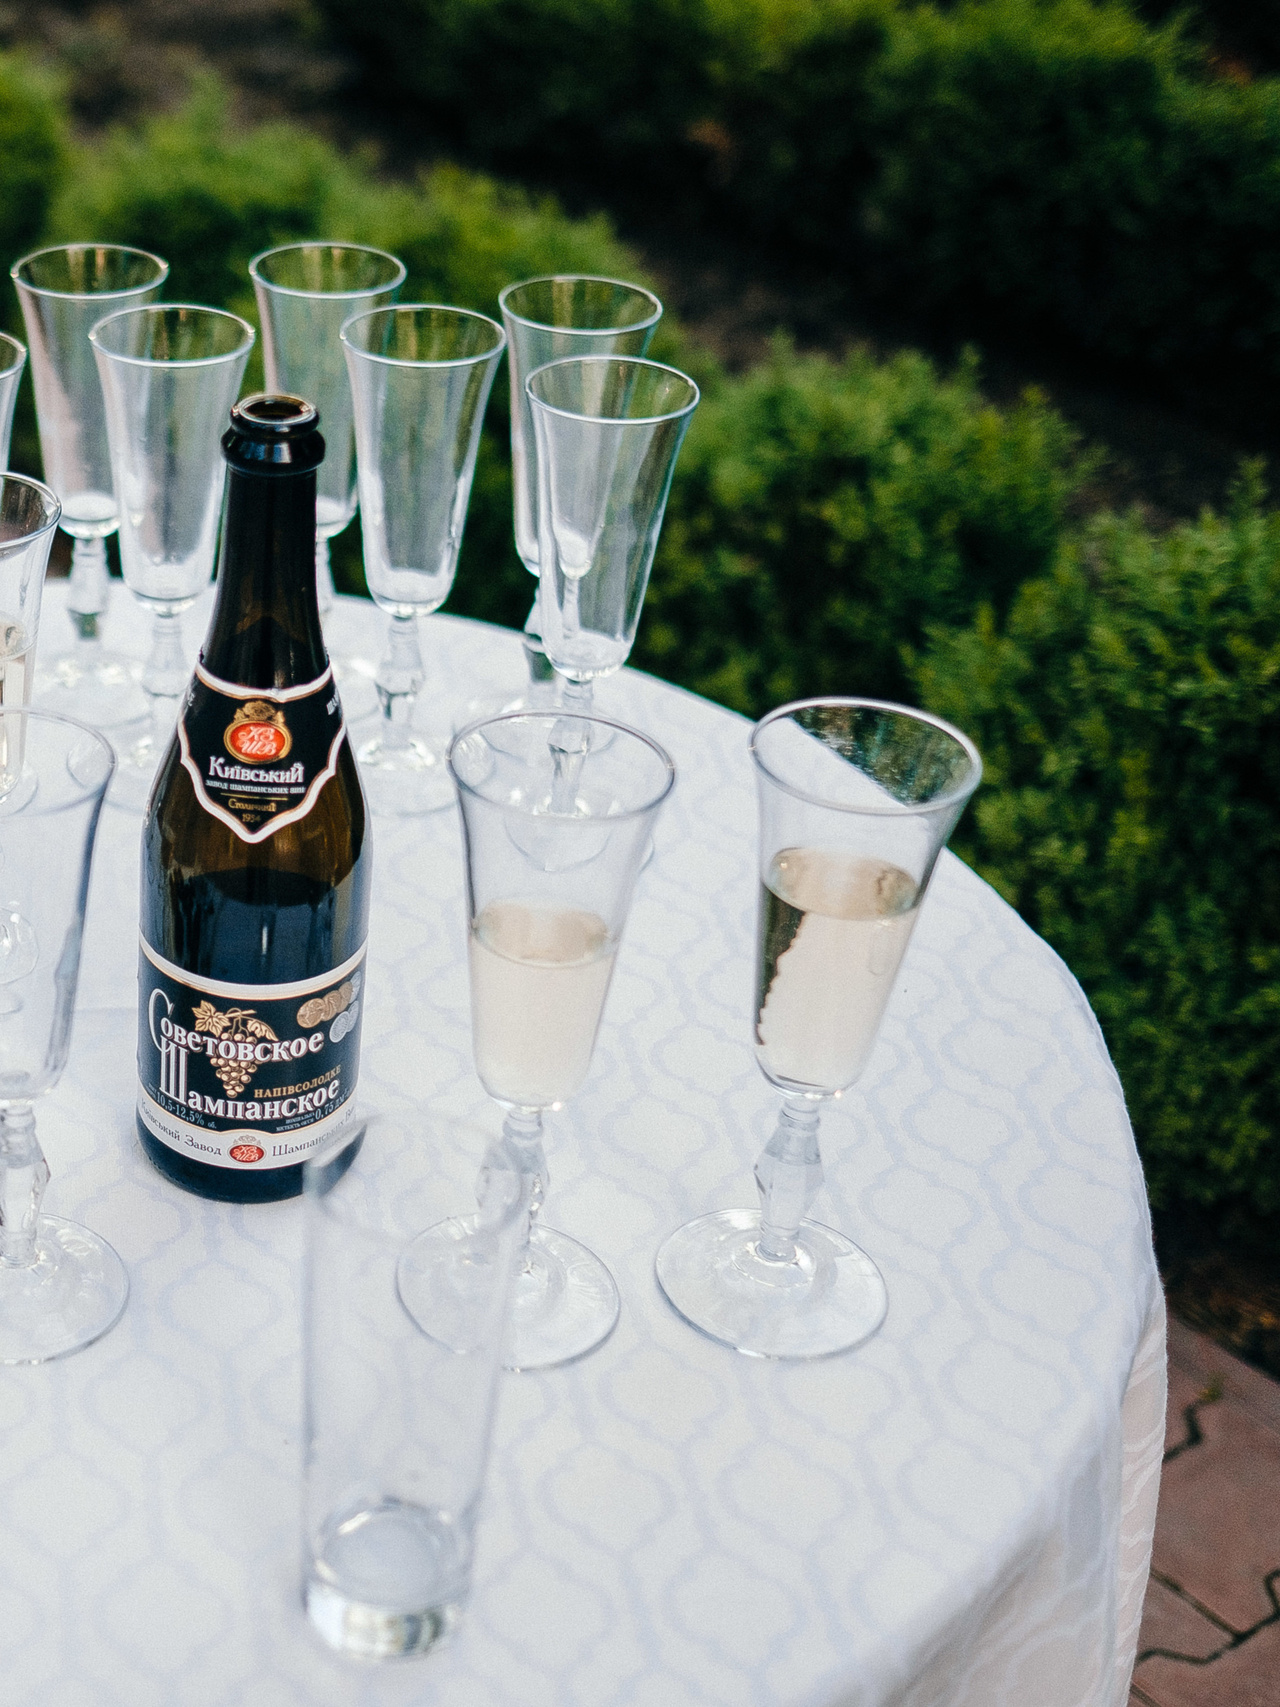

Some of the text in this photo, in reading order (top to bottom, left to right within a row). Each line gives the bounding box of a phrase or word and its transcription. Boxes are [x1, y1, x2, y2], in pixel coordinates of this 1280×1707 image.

[149, 988, 325, 1062] Советовское
[159, 1034, 341, 1121] Шампанское
[254, 1064, 342, 1099] НАПІВСОЛОДКЕ
[184, 1134, 222, 1156] Завод
